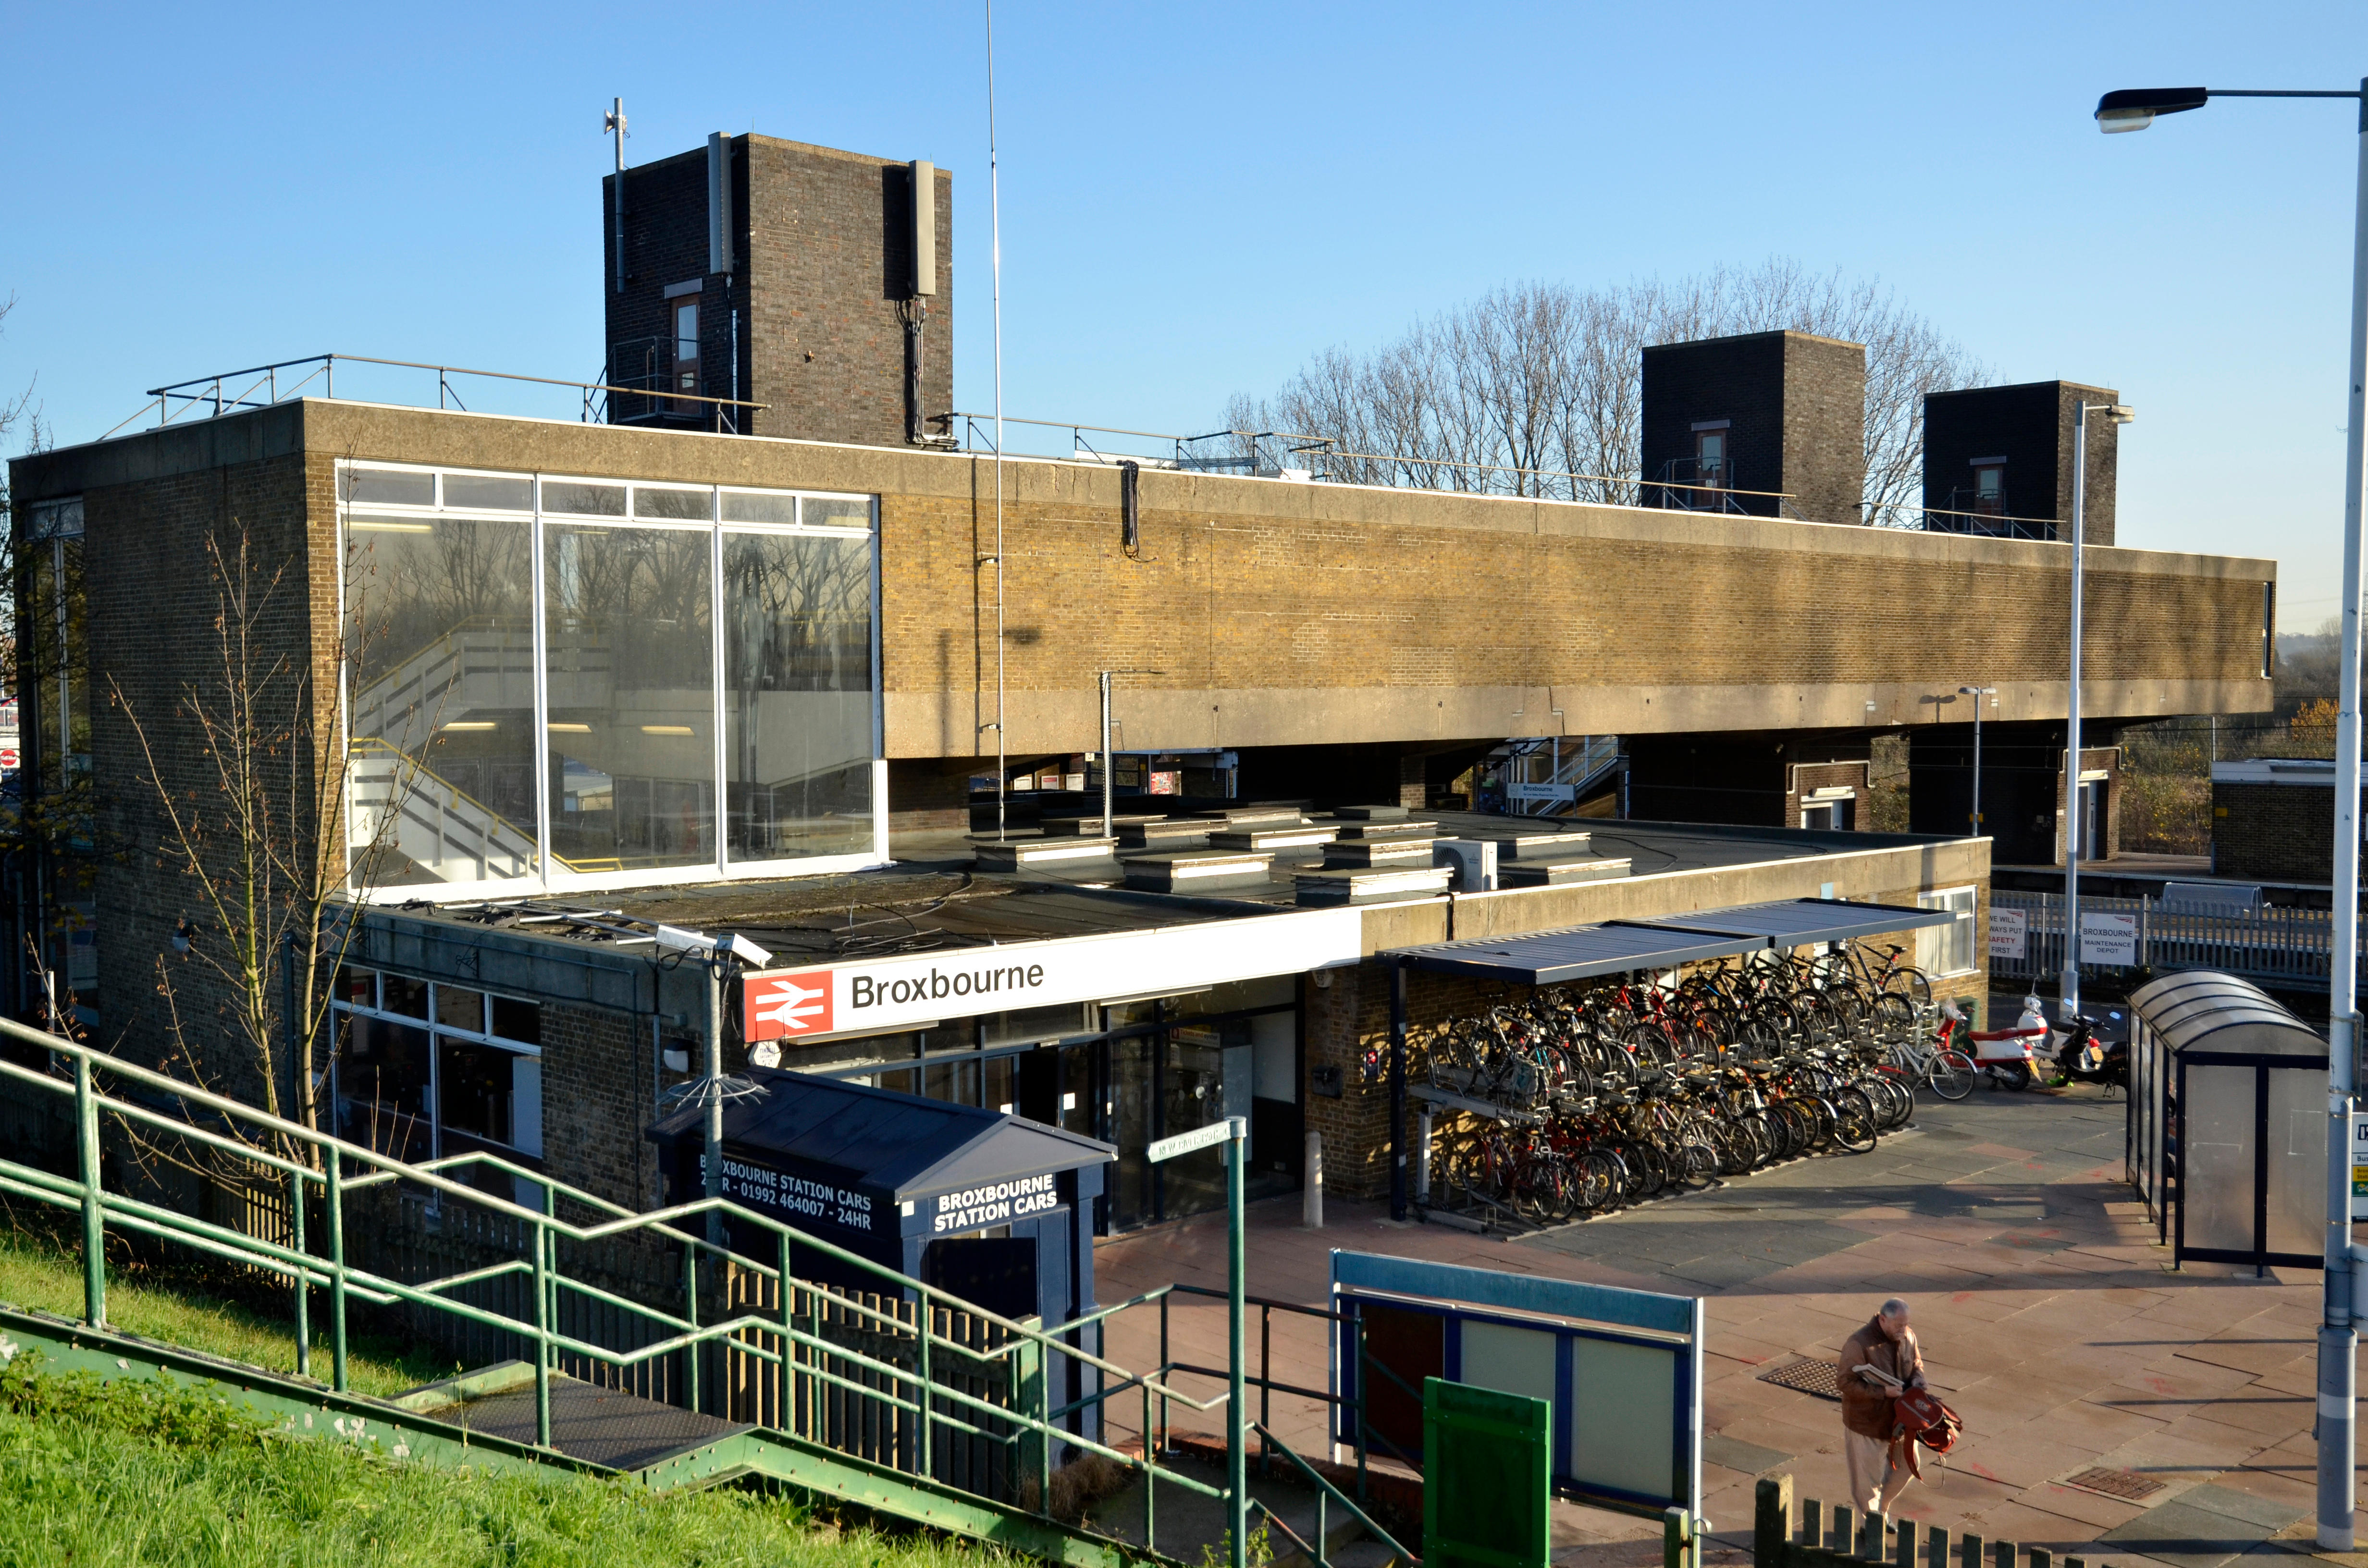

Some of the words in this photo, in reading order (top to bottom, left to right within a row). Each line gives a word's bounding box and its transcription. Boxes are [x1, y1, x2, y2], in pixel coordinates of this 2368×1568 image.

[2083, 928, 2133, 937] BROXBOURNE
[852, 964, 1044, 1009] Broxbourne
[700, 1154, 777, 1187] BXBOURNE
[780, 1175, 834, 1202] STATION
[838, 1189, 871, 1211] CARS
[701, 1171, 730, 1192] 2R
[741, 1182, 776, 1204] 01992
[780, 1193, 824, 1217] 464007
[838, 1207, 871, 1230] 24HR
[939, 1174, 1053, 1213] BROXBOURNE
[935, 1201, 1010, 1232] STATION
[1014, 1191, 1057, 1214] CARS
